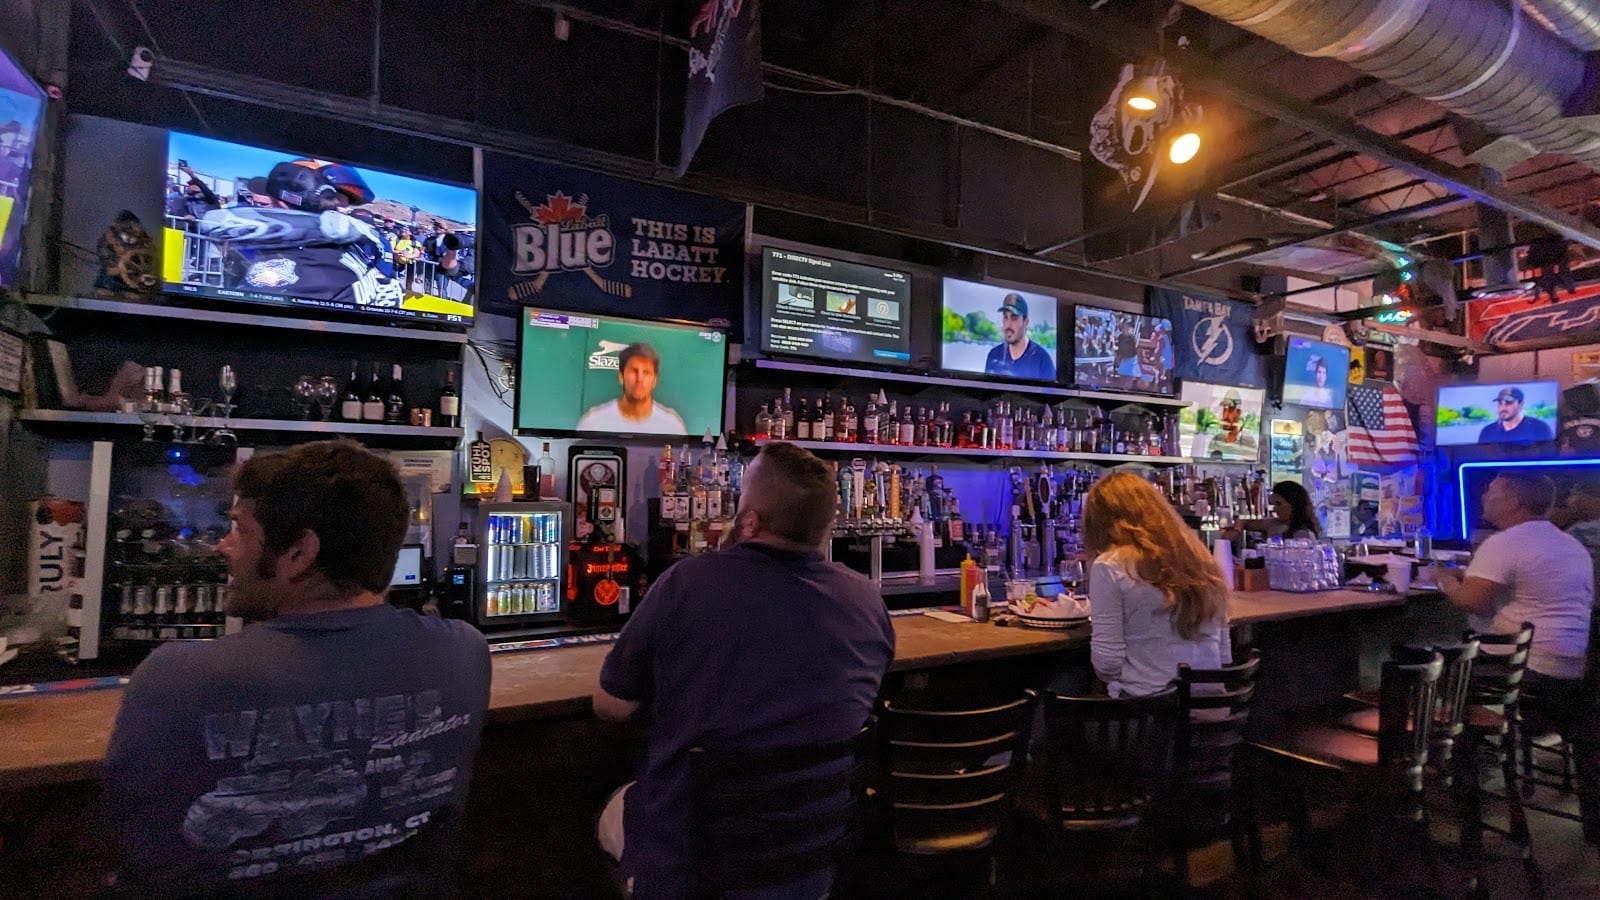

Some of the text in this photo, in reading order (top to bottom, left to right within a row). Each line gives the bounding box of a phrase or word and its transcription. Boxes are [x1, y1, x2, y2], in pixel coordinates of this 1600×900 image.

[631, 217, 716, 244] THIS IS
[513, 222, 614, 272] Blue
[631, 238, 720, 264] LABATT
[447, 314, 462, 322] FS1
[404, 812, 432, 835] CT
